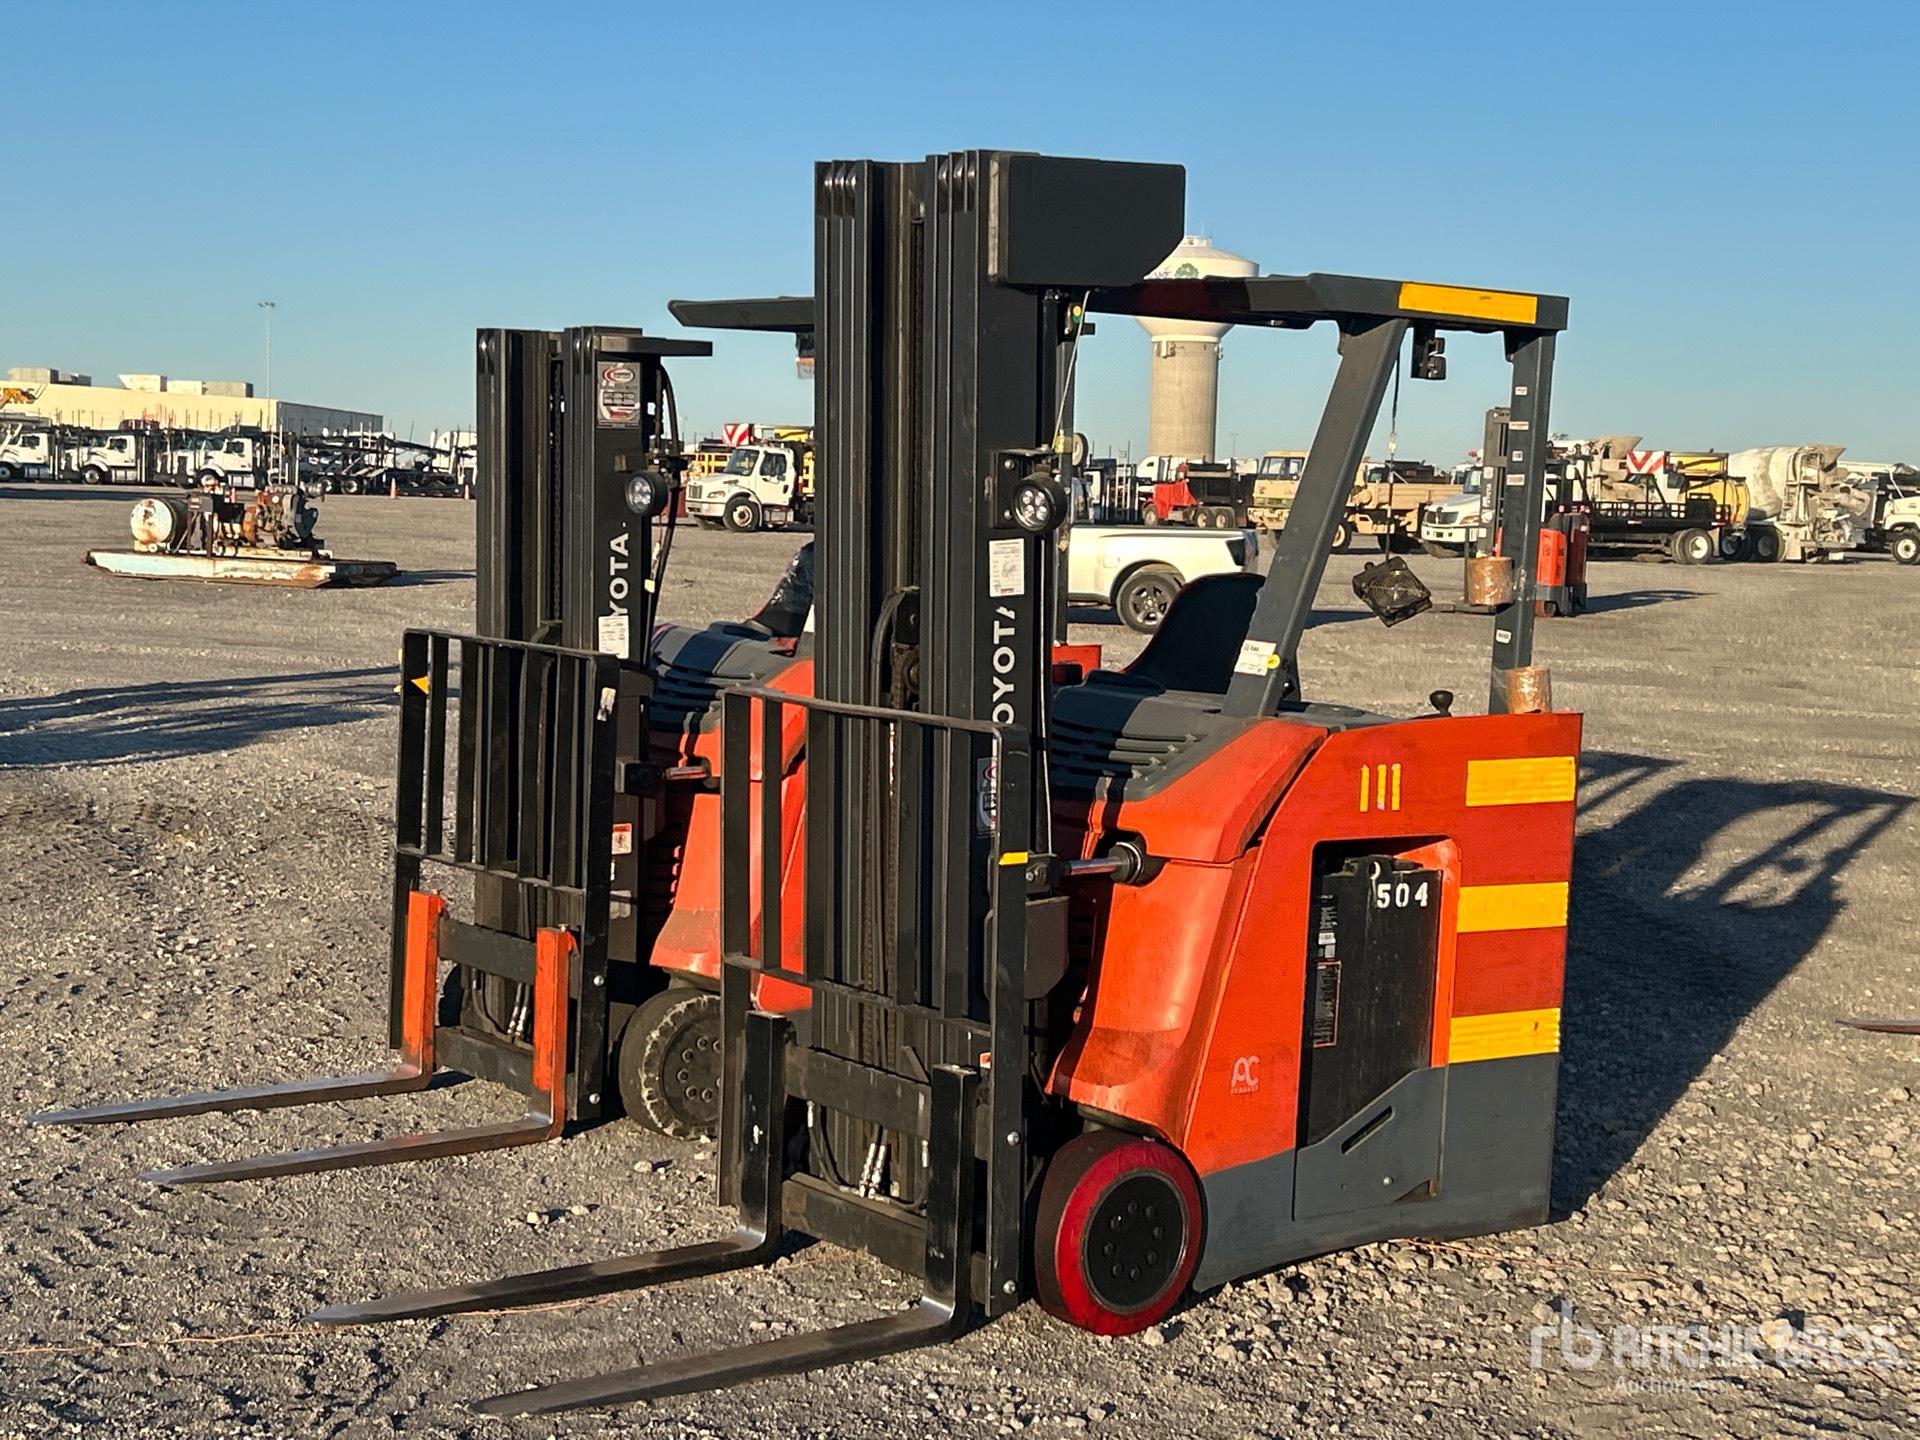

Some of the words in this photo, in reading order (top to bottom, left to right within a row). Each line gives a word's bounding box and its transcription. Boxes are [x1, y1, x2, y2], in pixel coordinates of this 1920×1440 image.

[609, 533, 629, 616] YOTA
[992, 606, 1016, 725] OYOT
[1376, 882, 1428, 909] 504
